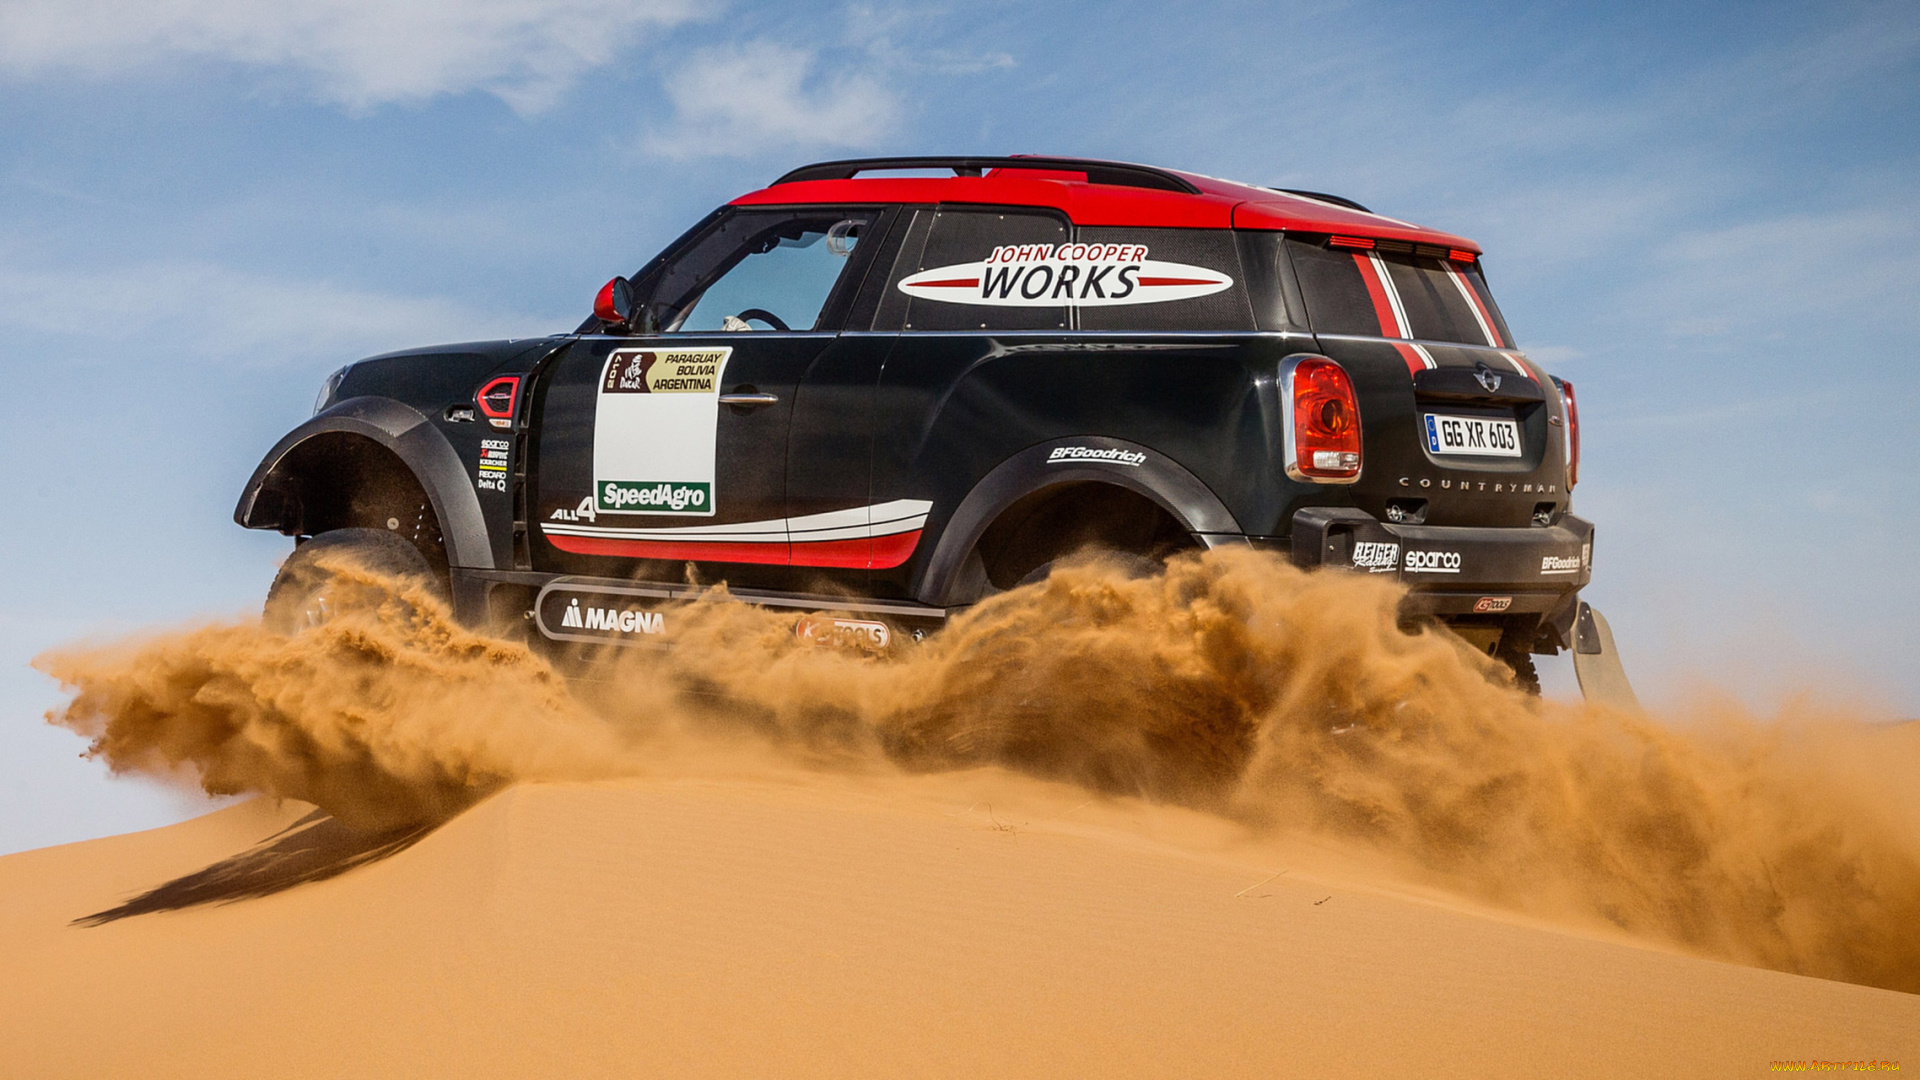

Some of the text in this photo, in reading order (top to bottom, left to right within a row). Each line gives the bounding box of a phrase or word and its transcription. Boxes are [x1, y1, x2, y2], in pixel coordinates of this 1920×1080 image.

[987, 244, 1147, 264] JOHN COOPER
[981, 264, 1142, 300] WORKS
[665, 354, 722, 364] PARAGUAY
[607, 355, 622, 389] 2017
[676, 365, 716, 376] BOLIVIA
[653, 378, 712, 390] ARGENTINA
[1431, 437, 1437, 446] D
[1441, 420, 1516, 450] GG XR 603
[1049, 446, 1147, 464] BFGoodrich
[478, 479, 506, 493] Delta Q
[1399, 477, 1556, 494] COUNTRYMAN
[603, 482, 705, 511] SpeedAgro
[1405, 550, 1461, 573] sparco
[1541, 556, 1581, 570] BFGoodrich
[585, 607, 667, 635] MAGNA
